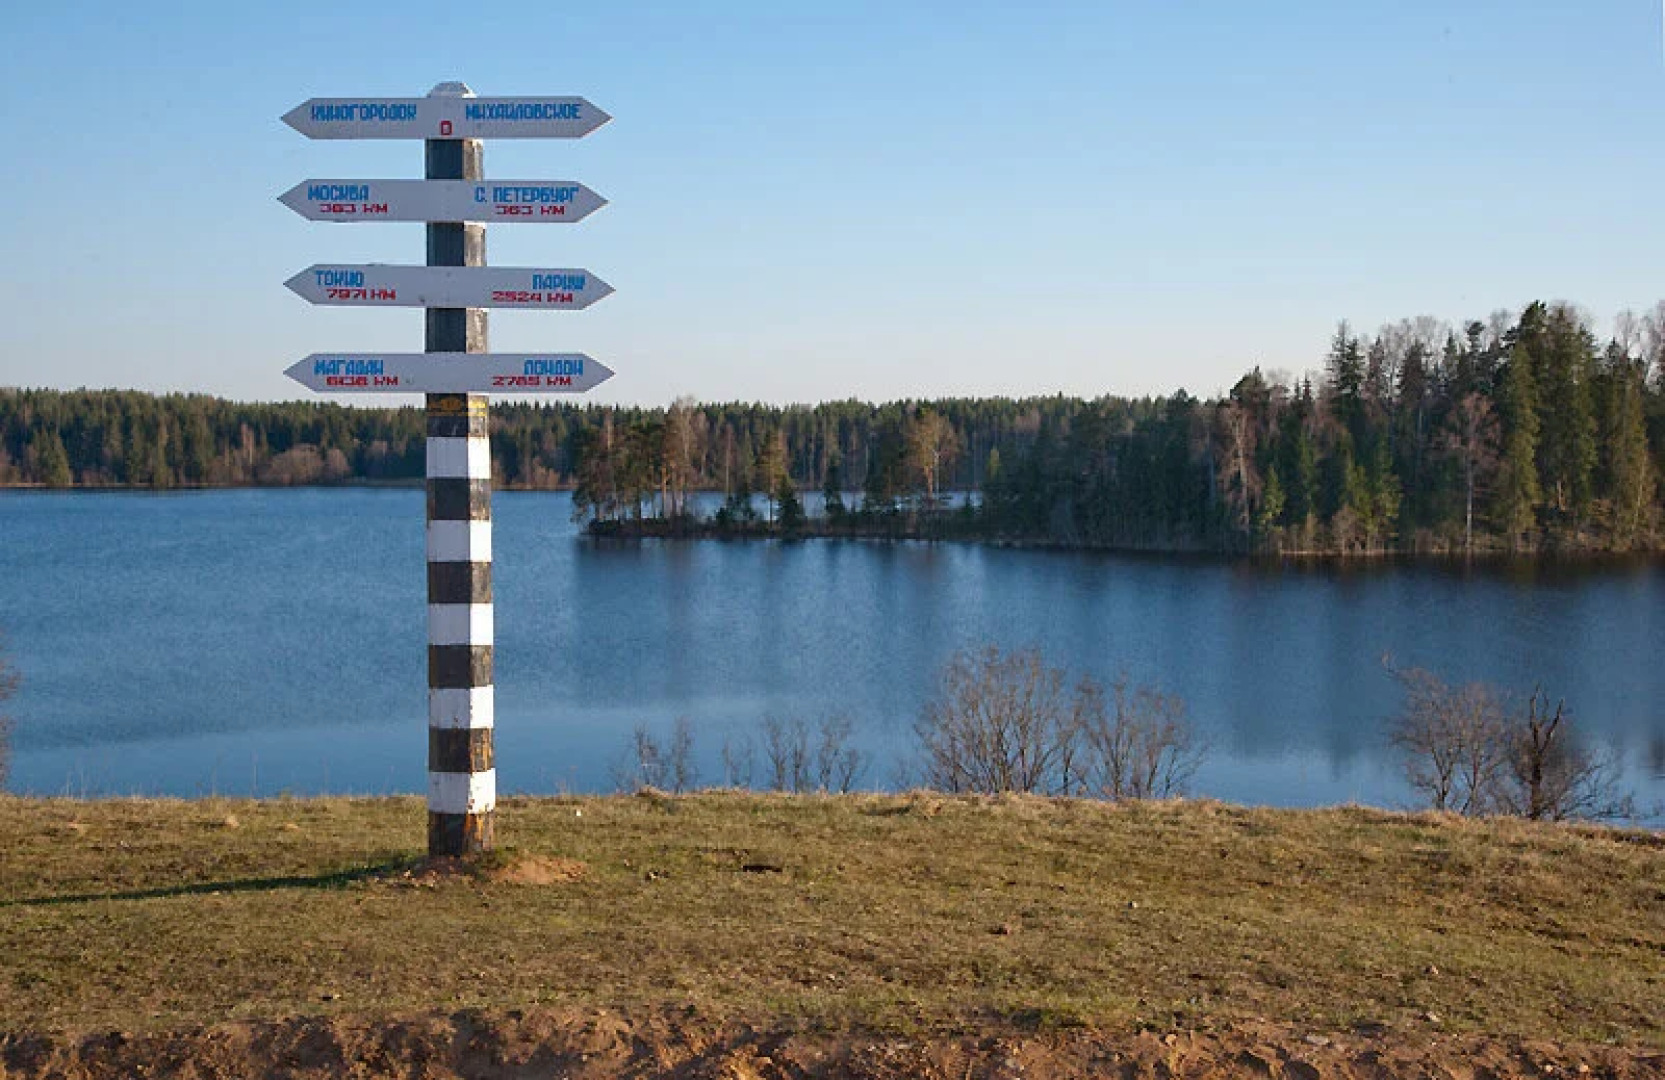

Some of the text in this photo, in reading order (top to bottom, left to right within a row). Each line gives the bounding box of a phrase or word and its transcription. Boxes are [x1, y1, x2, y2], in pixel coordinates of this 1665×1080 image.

[311, 103, 417, 121] КИНОГОРОДОК
[465, 103, 581, 120] МИХАЙЛОВСКОЕ
[307, 184, 369, 201] МОСКВА
[475, 187, 579, 203] С. ПЕТЕРБУРГ
[315, 269, 365, 287] ТОКИО
[532, 274, 586, 291] ПАРИЖ
[314, 359, 384, 375] МАГАДАН
[524, 359, 583, 375] ЛОНДОН
